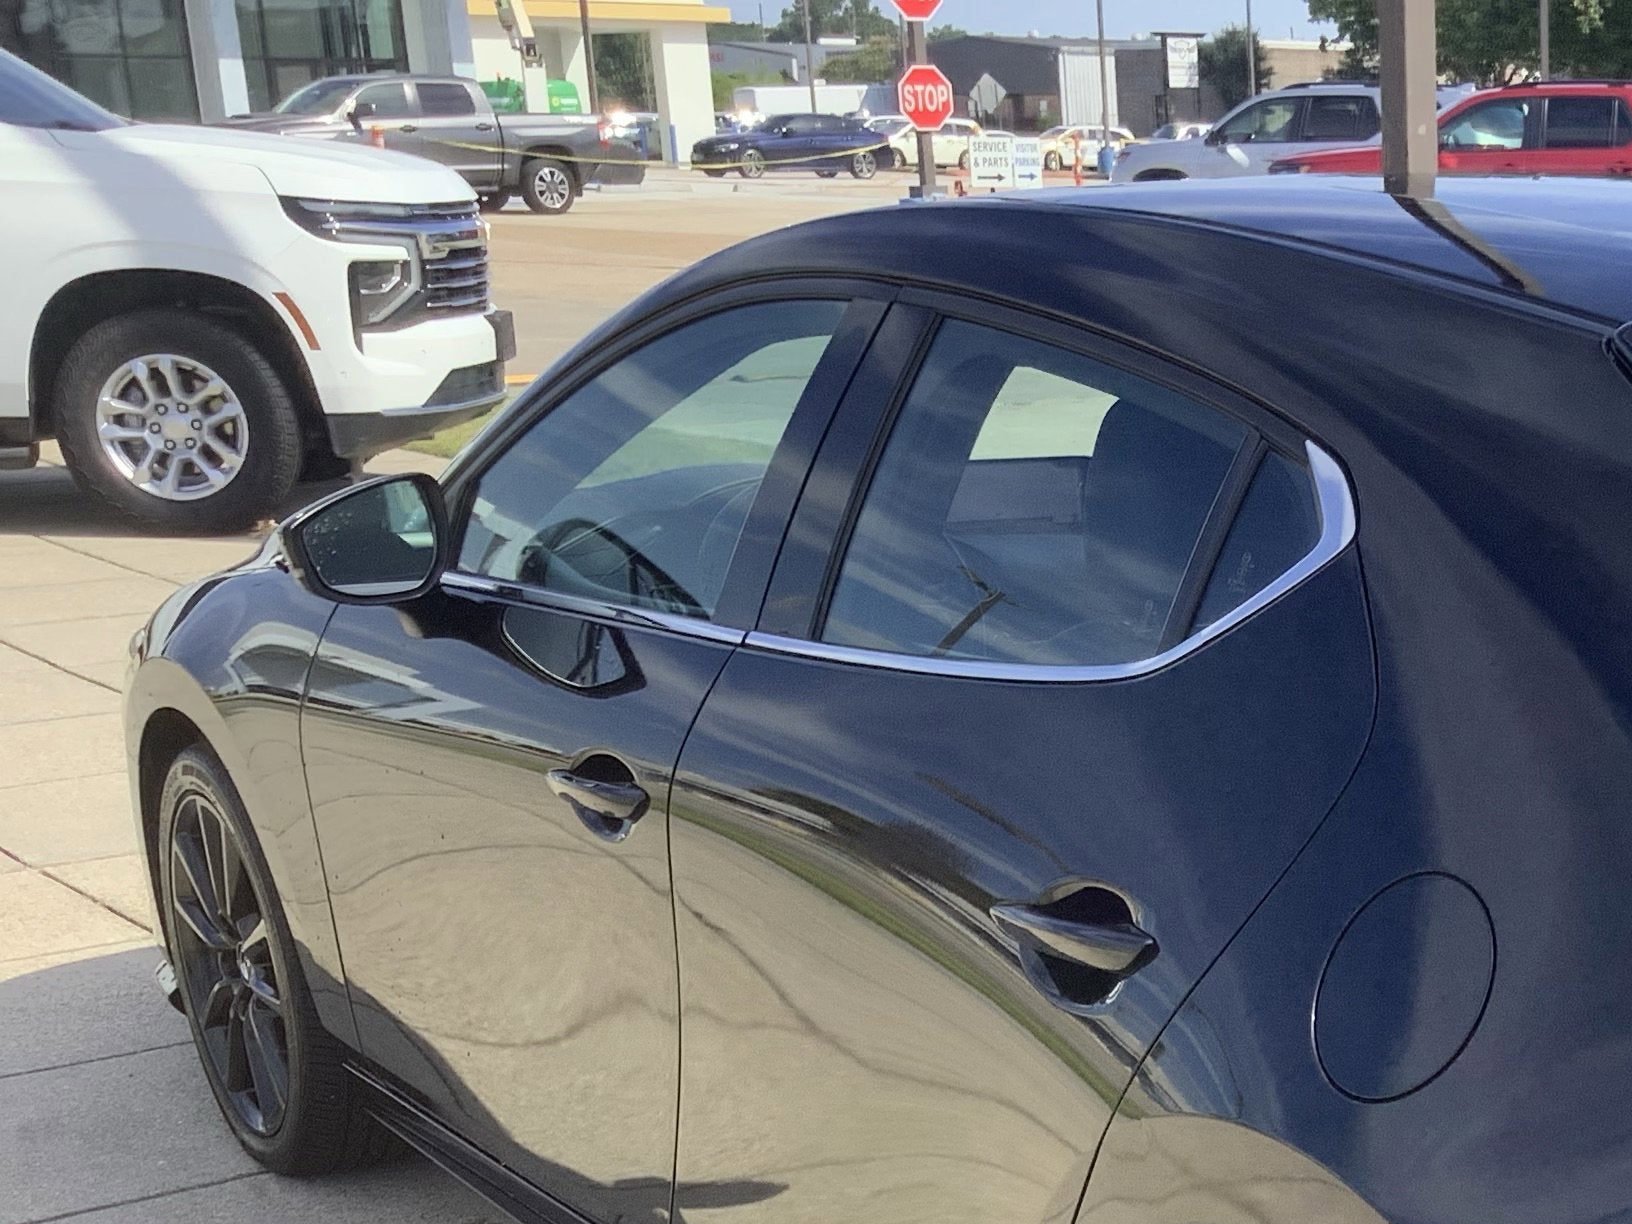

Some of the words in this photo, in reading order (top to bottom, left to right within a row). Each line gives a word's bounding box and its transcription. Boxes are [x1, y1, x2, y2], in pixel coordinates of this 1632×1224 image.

[903, 83, 948, 113] STOP
[972, 141, 1008, 153] SERVICE
[973, 157, 980, 168] &
[982, 156, 1009, 168] PARTS
